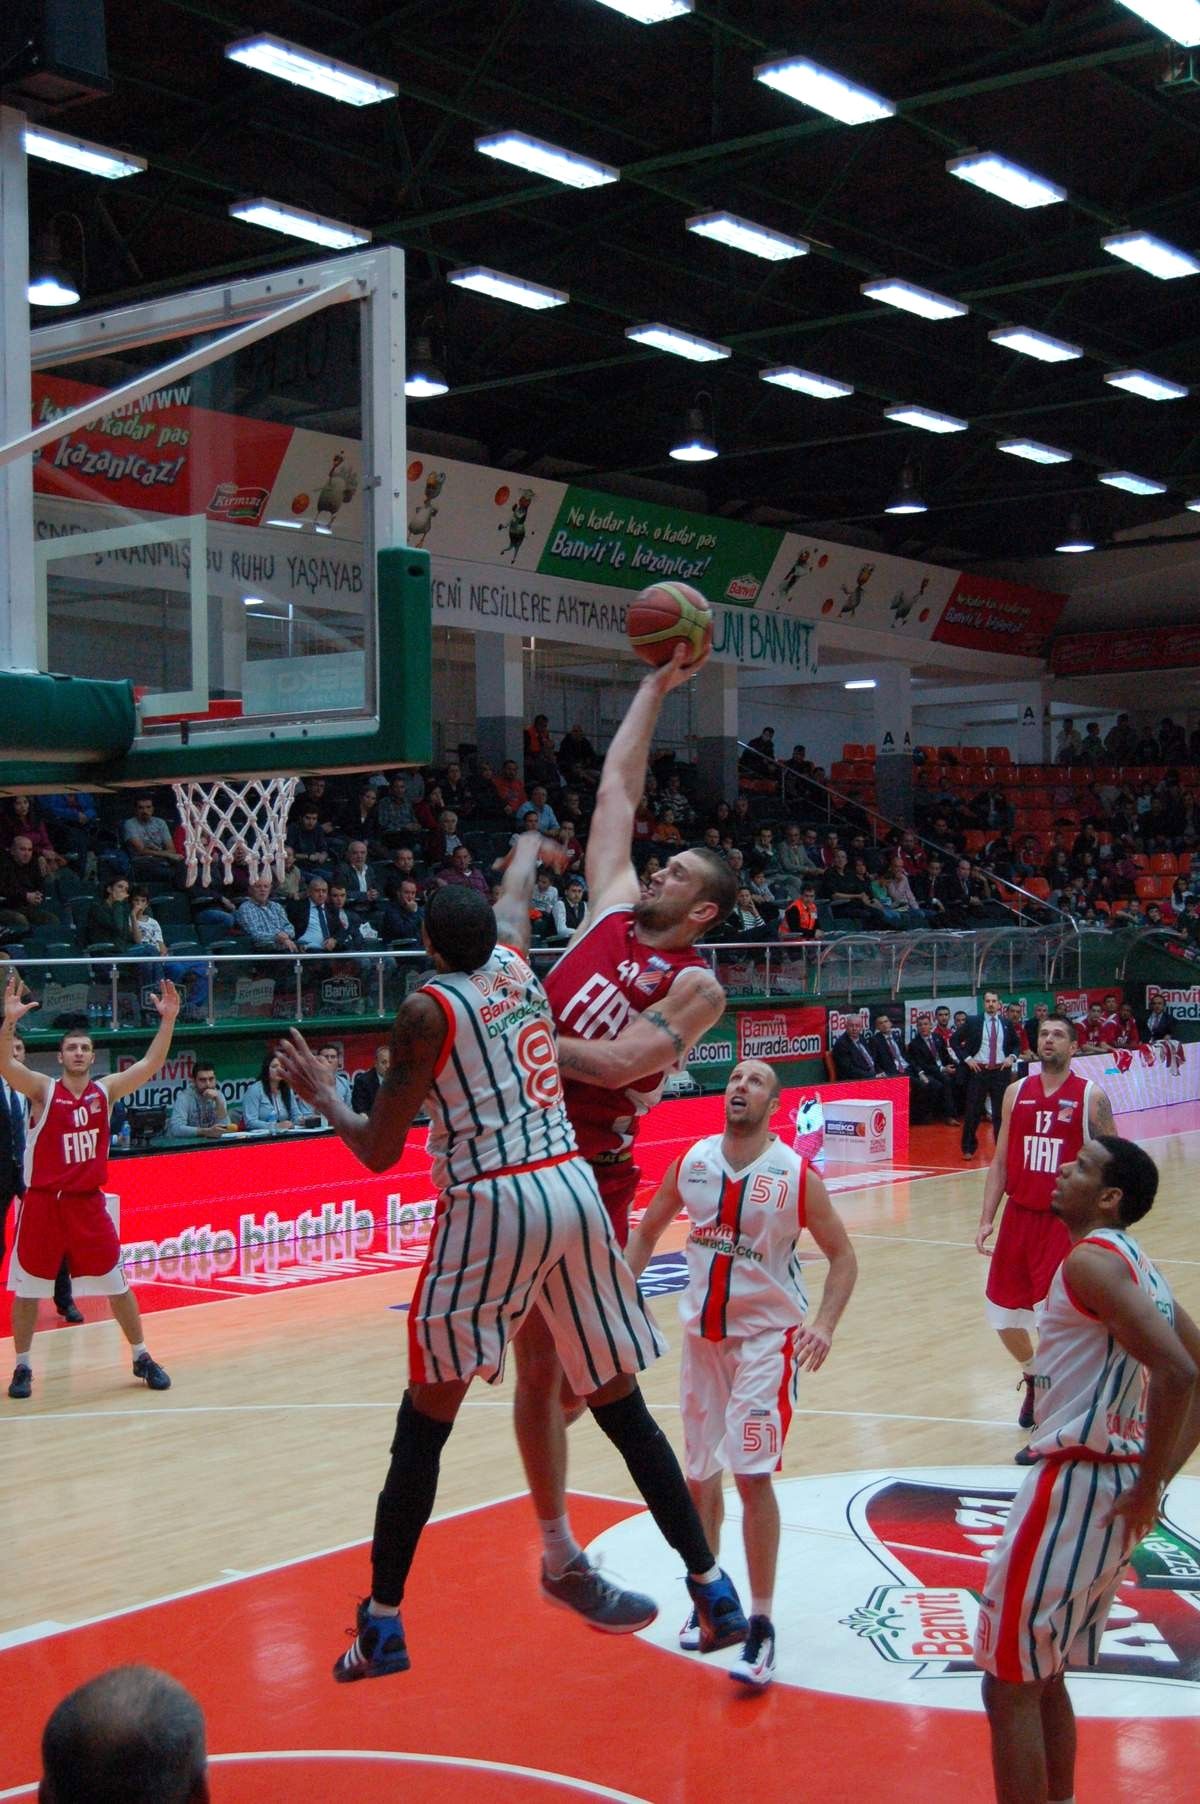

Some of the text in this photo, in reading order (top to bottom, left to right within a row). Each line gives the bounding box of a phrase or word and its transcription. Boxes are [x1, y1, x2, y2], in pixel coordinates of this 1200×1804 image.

[100, 415, 156, 440] kadar
[157, 427, 191, 447] pas
[567, 507, 585, 525] Ne
[588, 510, 625, 533] kadar
[663, 523, 696, 546] kadar
[697, 532, 718, 550] pas
[551, 530, 627, 569] Banvit'le
[231, 551, 275, 582] RUHU
[556, 594, 631, 634] AKTARAB
[730, 582, 759, 598] Banvit
[1023, 706, 1035, 719] A
[883, 731, 895, 745] A
[558, 972, 632, 1040] FIA
[1148, 986, 1200, 1003] Banvi
[742, 1014, 787, 1038] Banvit
[742, 1036, 820, 1057] burada.com
[73, 1105, 89, 1128] 10
[1035, 1110, 1054, 1134] 13
[63, 1127, 100, 1165] FIAT
[1023, 1135, 1064, 1174] FIAT
[750, 1174, 789, 1210] 51
[743, 1421, 777, 1453] 51
[901, 1591, 974, 1656] Banvit
